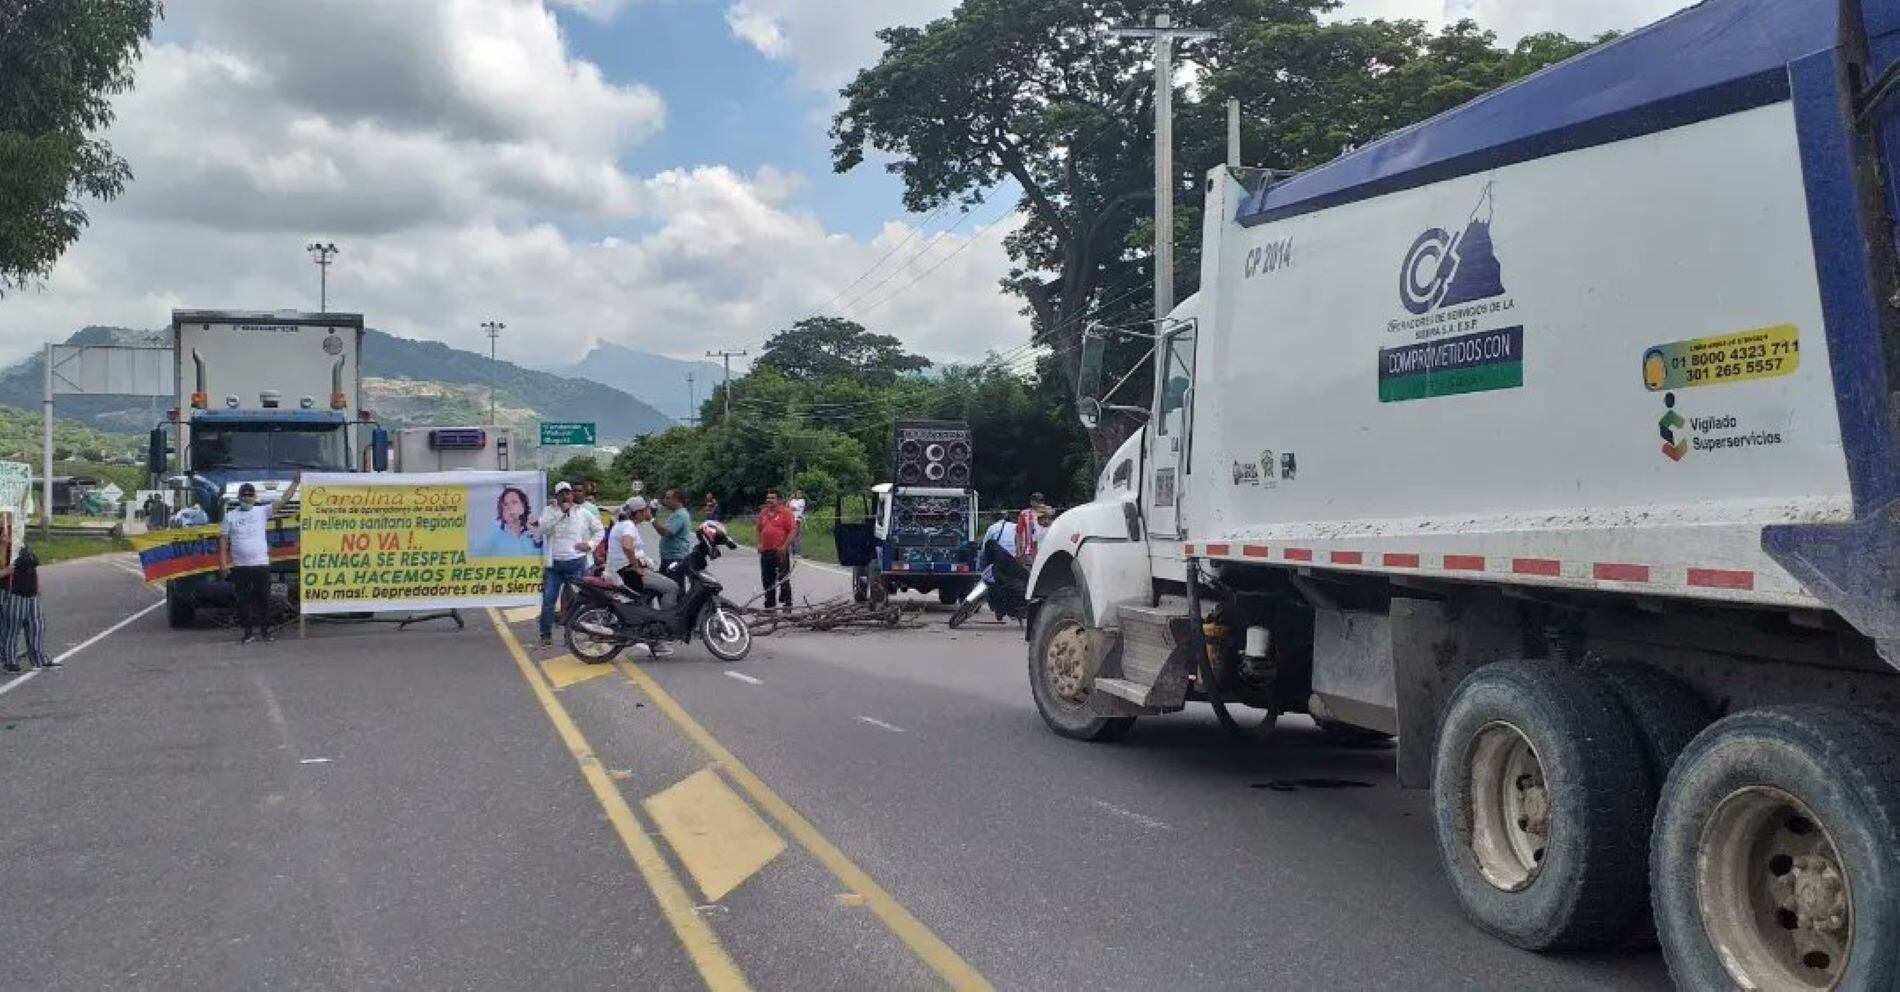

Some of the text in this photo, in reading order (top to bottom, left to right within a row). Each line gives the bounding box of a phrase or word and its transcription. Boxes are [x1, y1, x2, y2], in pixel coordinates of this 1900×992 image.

[1245, 235, 1294, 279] CP 2014
[1503, 298, 1515, 311] LA
[1388, 333, 1510, 374] COMPROMETIDOS CON
[1672, 357, 1686, 370] 01
[1691, 350, 1726, 366] 8000
[1730, 343, 1767, 361] 4323
[1771, 338, 1800, 356] 711
[1686, 357, 1784, 382] 301 265 5557
[1690, 415, 1737, 434] Vigilado
[1692, 431, 1782, 452] Superservicios
[308, 486, 463, 507] Carolina Soto
[301, 513, 467, 532] El relleno sanitario Regional
[340, 533, 371, 553] NO
[376, 531, 400, 551] VA
[376, 552, 395, 568] SE
[400, 549, 467, 568] RESPETA
[304, 572, 318, 587] O
[323, 572, 347, 586] LA
[352, 569, 445, 585] HACEMOS
[371, 584, 467, 601] Depredadores
[470, 583, 487, 596] de
[490, 581, 504, 595] la
